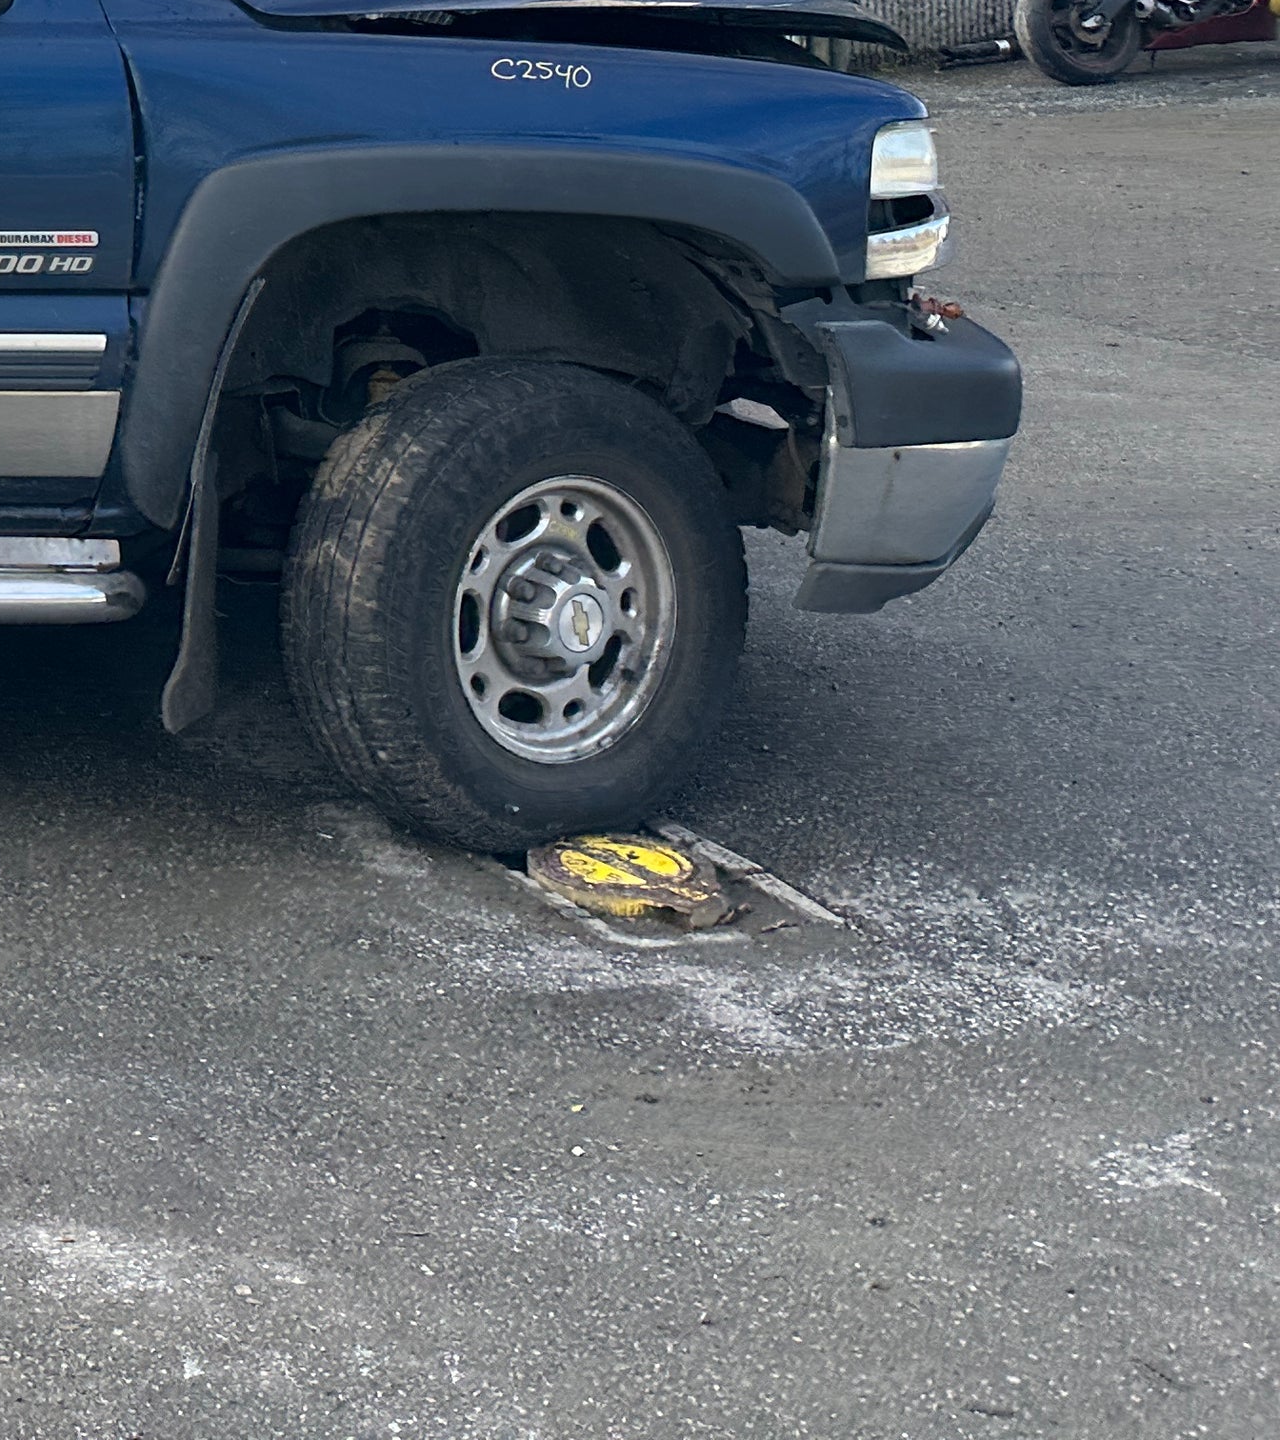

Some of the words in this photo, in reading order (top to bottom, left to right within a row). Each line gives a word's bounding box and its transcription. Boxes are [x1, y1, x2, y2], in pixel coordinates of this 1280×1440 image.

[491, 58, 592, 88] C2540
[0, 234, 55, 244] DURAMAX
[56, 234, 95, 244] DIESEL
